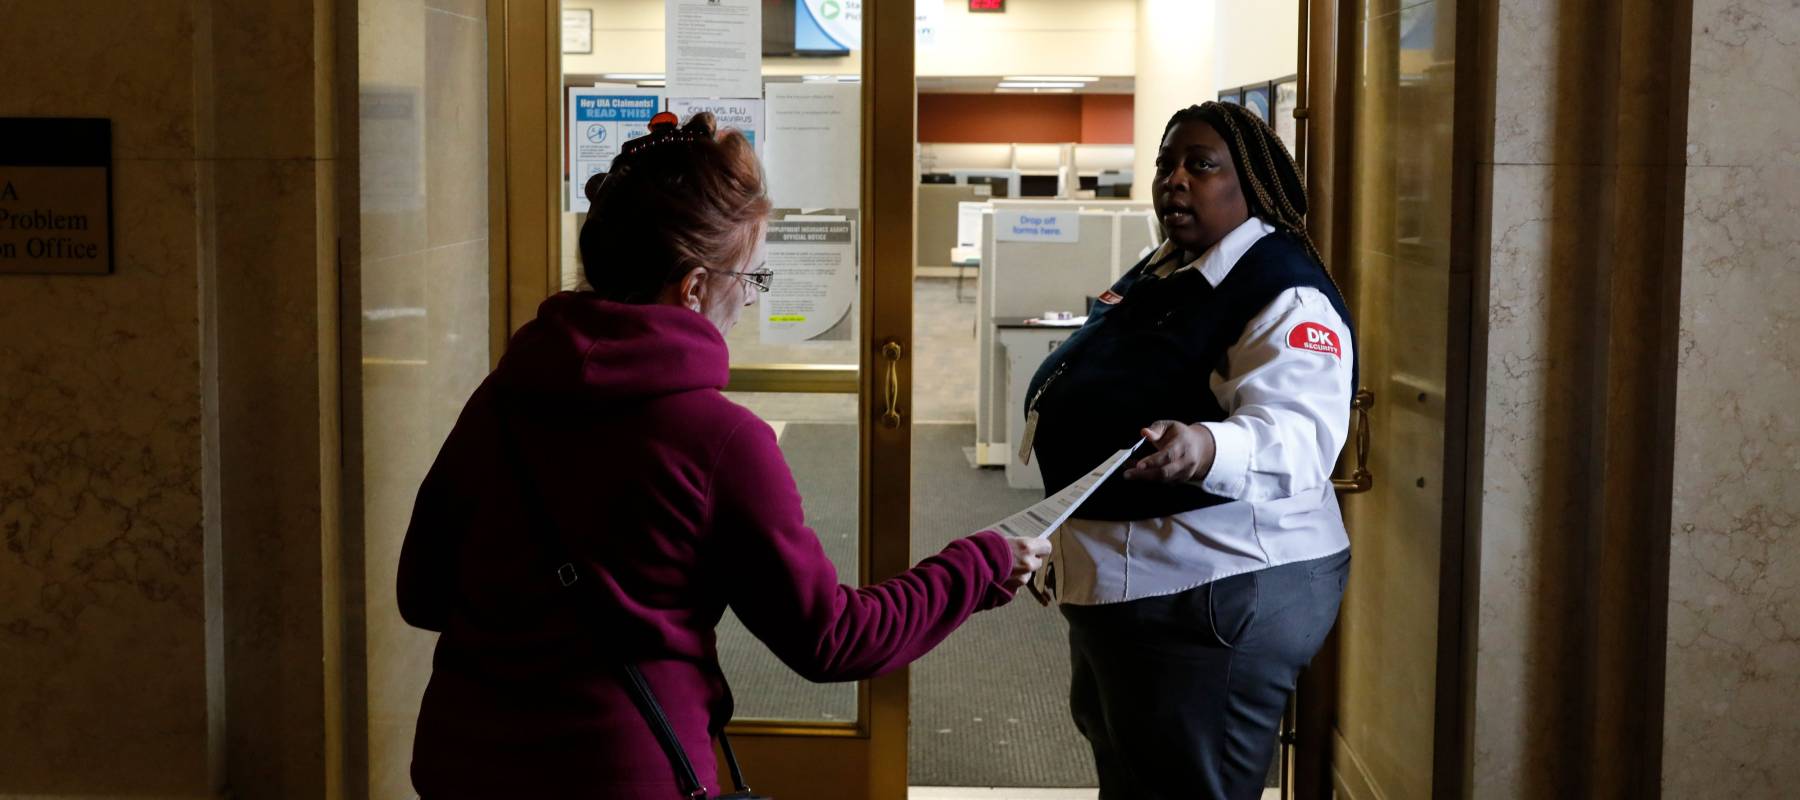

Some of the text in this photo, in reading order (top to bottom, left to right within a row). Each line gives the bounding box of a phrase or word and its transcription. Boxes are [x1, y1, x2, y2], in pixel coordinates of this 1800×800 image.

[580, 98, 653, 108] Hey UIA Claimants!
[586, 108, 650, 118] READ THIS!
[729, 106, 747, 115] FLU
[0, 208, 88, 230] Problem
[1020, 215, 1056, 225] Drop off
[1012, 225, 1038, 234] forms
[783, 233, 806, 241] OFFICIAL
[27, 237, 97, 258] Office
[1306, 327, 1334, 346] DK
[1303, 341, 1338, 354] SECURITY
